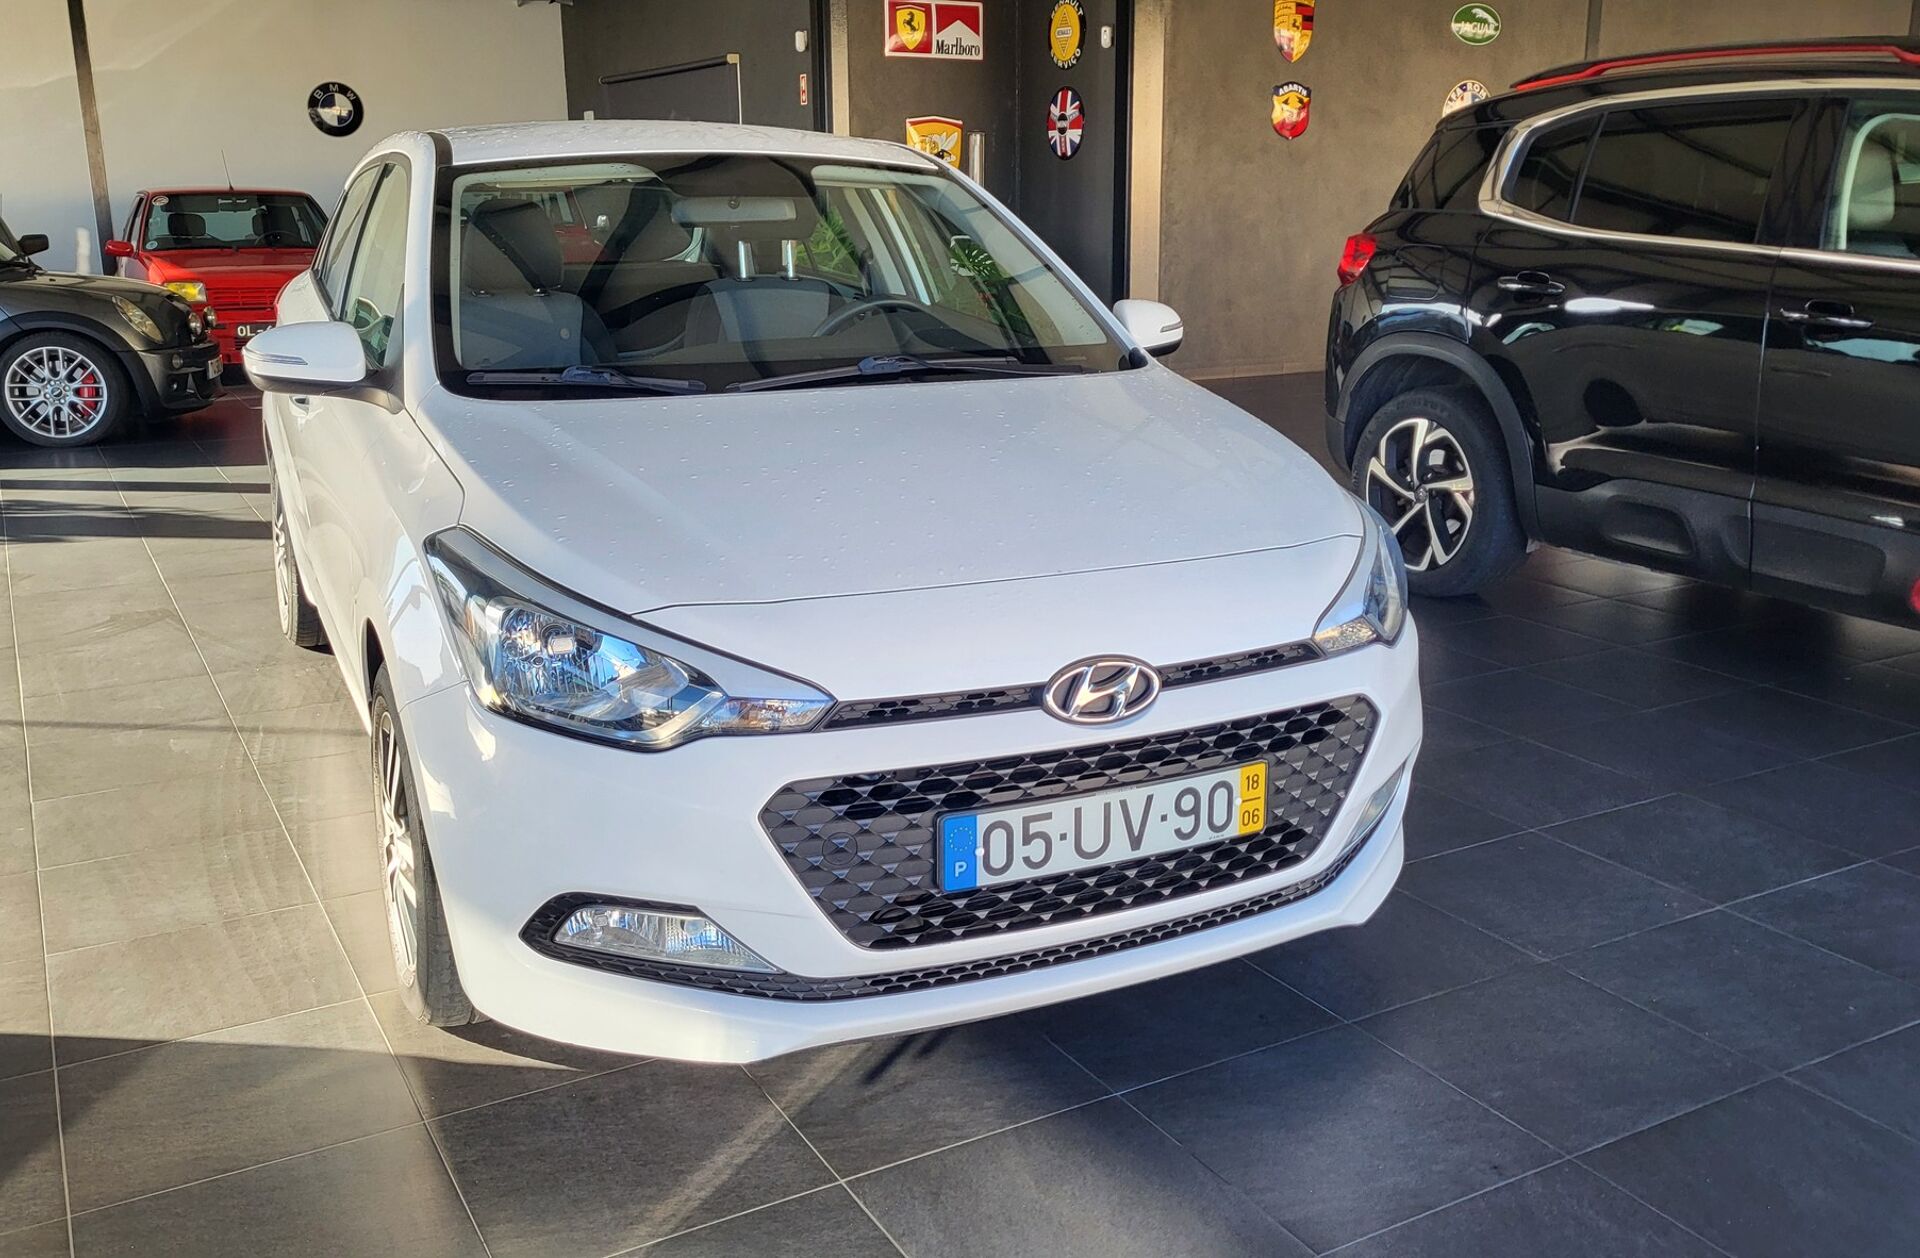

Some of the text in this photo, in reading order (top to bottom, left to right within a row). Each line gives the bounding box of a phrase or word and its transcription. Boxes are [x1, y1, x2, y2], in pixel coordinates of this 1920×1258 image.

[1459, 21, 1495, 35] JAGUAR
[935, 37, 980, 56] Marlboro
[313, 84, 356, 100] BMW
[1279, 83, 1307, 96] ABARTH
[1245, 774, 1259, 792] 18
[1241, 808, 1259, 827] 06
[955, 862, 968, 877] P
